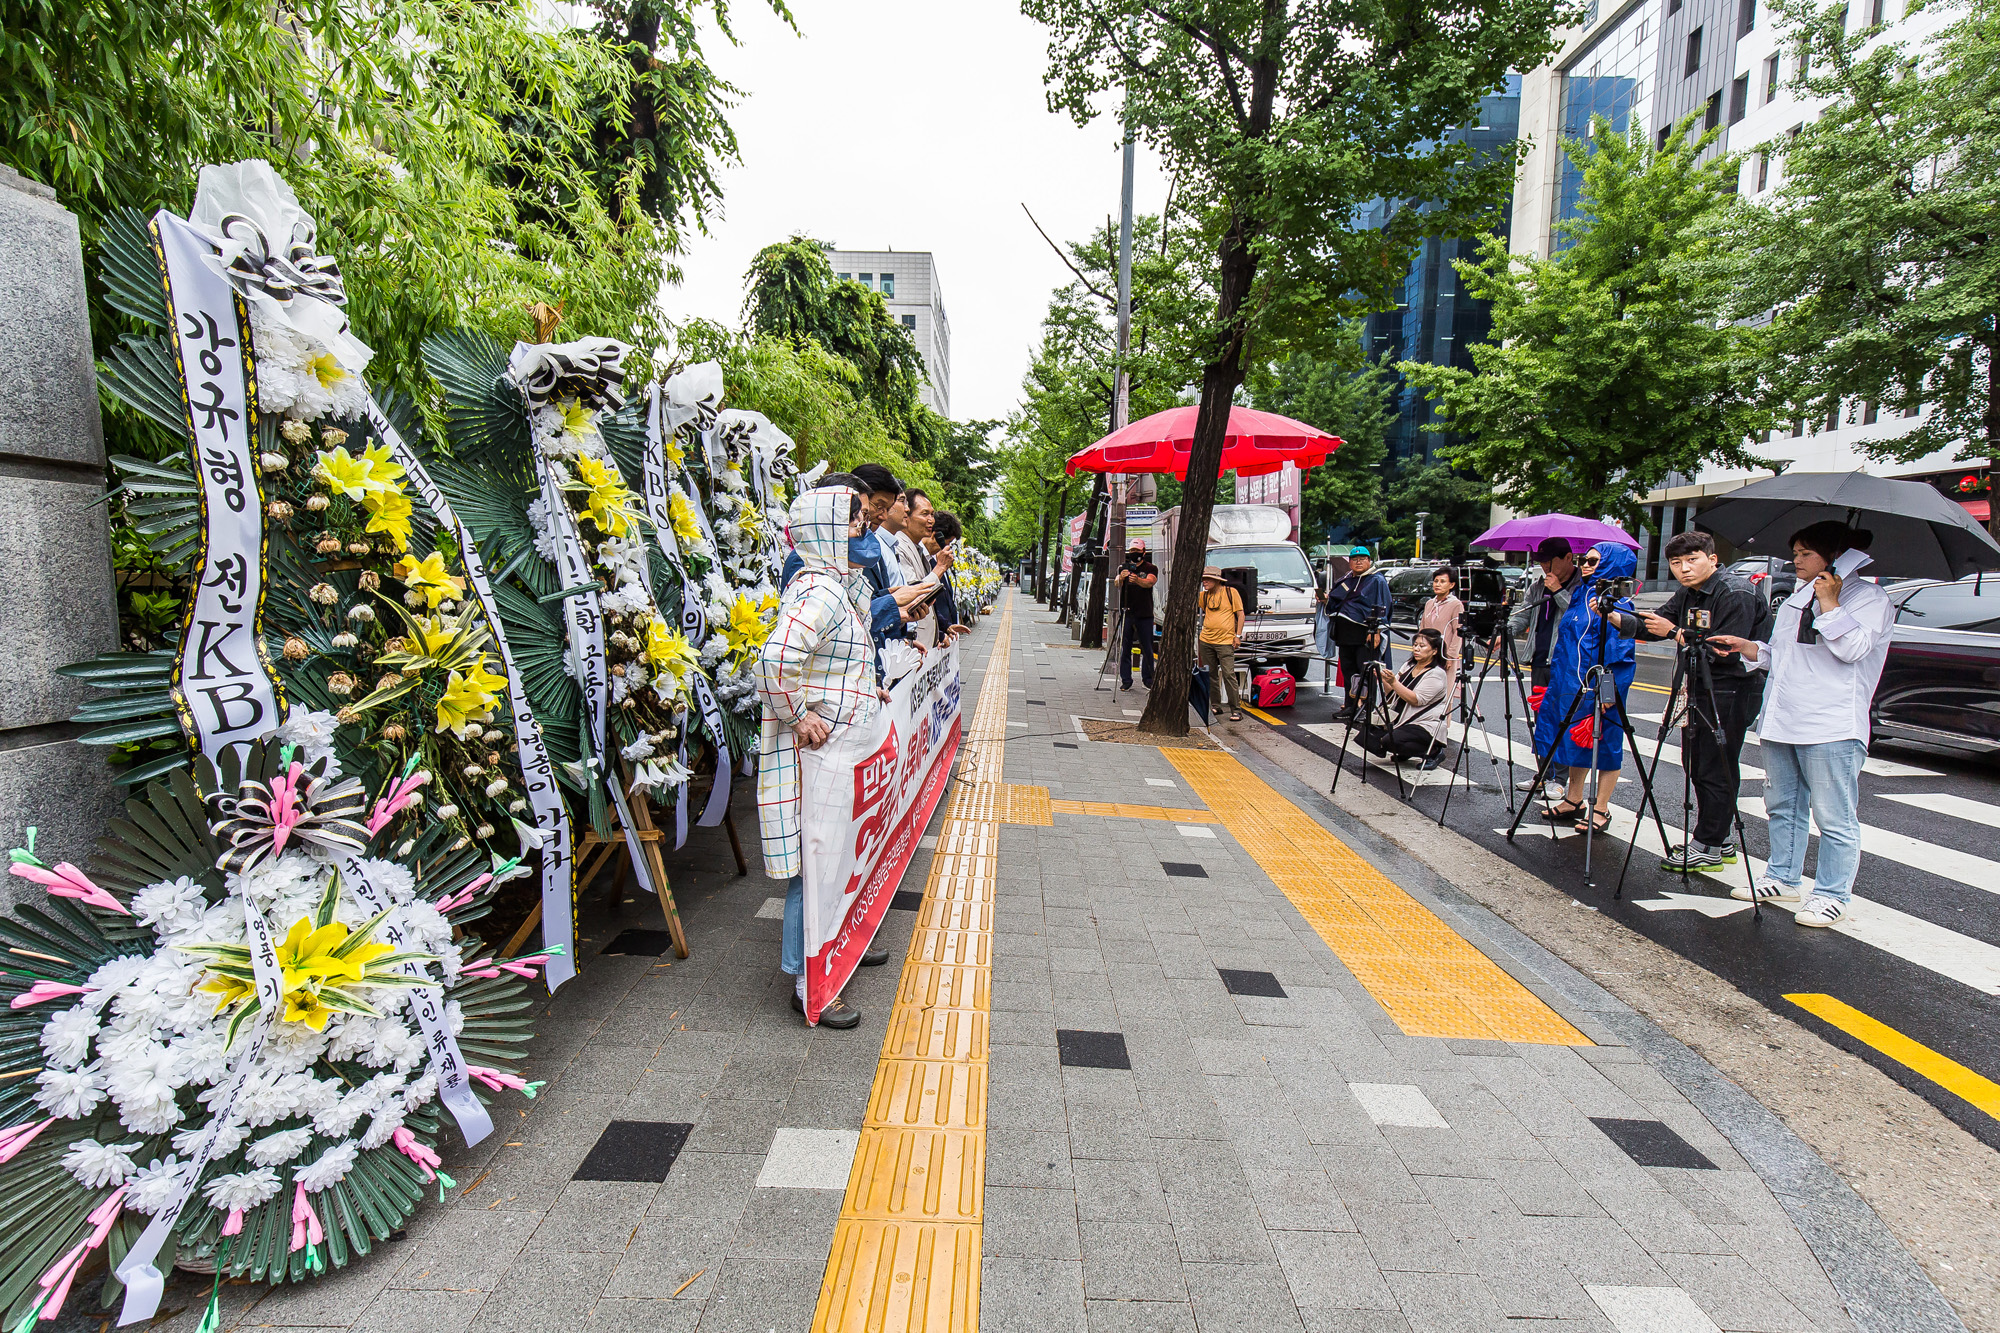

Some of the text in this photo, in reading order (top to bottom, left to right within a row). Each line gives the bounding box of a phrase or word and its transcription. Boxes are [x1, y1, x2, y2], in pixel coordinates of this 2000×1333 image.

[182, 309, 246, 514] 강규형
[646, 440, 670, 531] KBS
[246, 895, 274, 968] 이영풍
[432, 1029, 462, 1089] 류재룡
